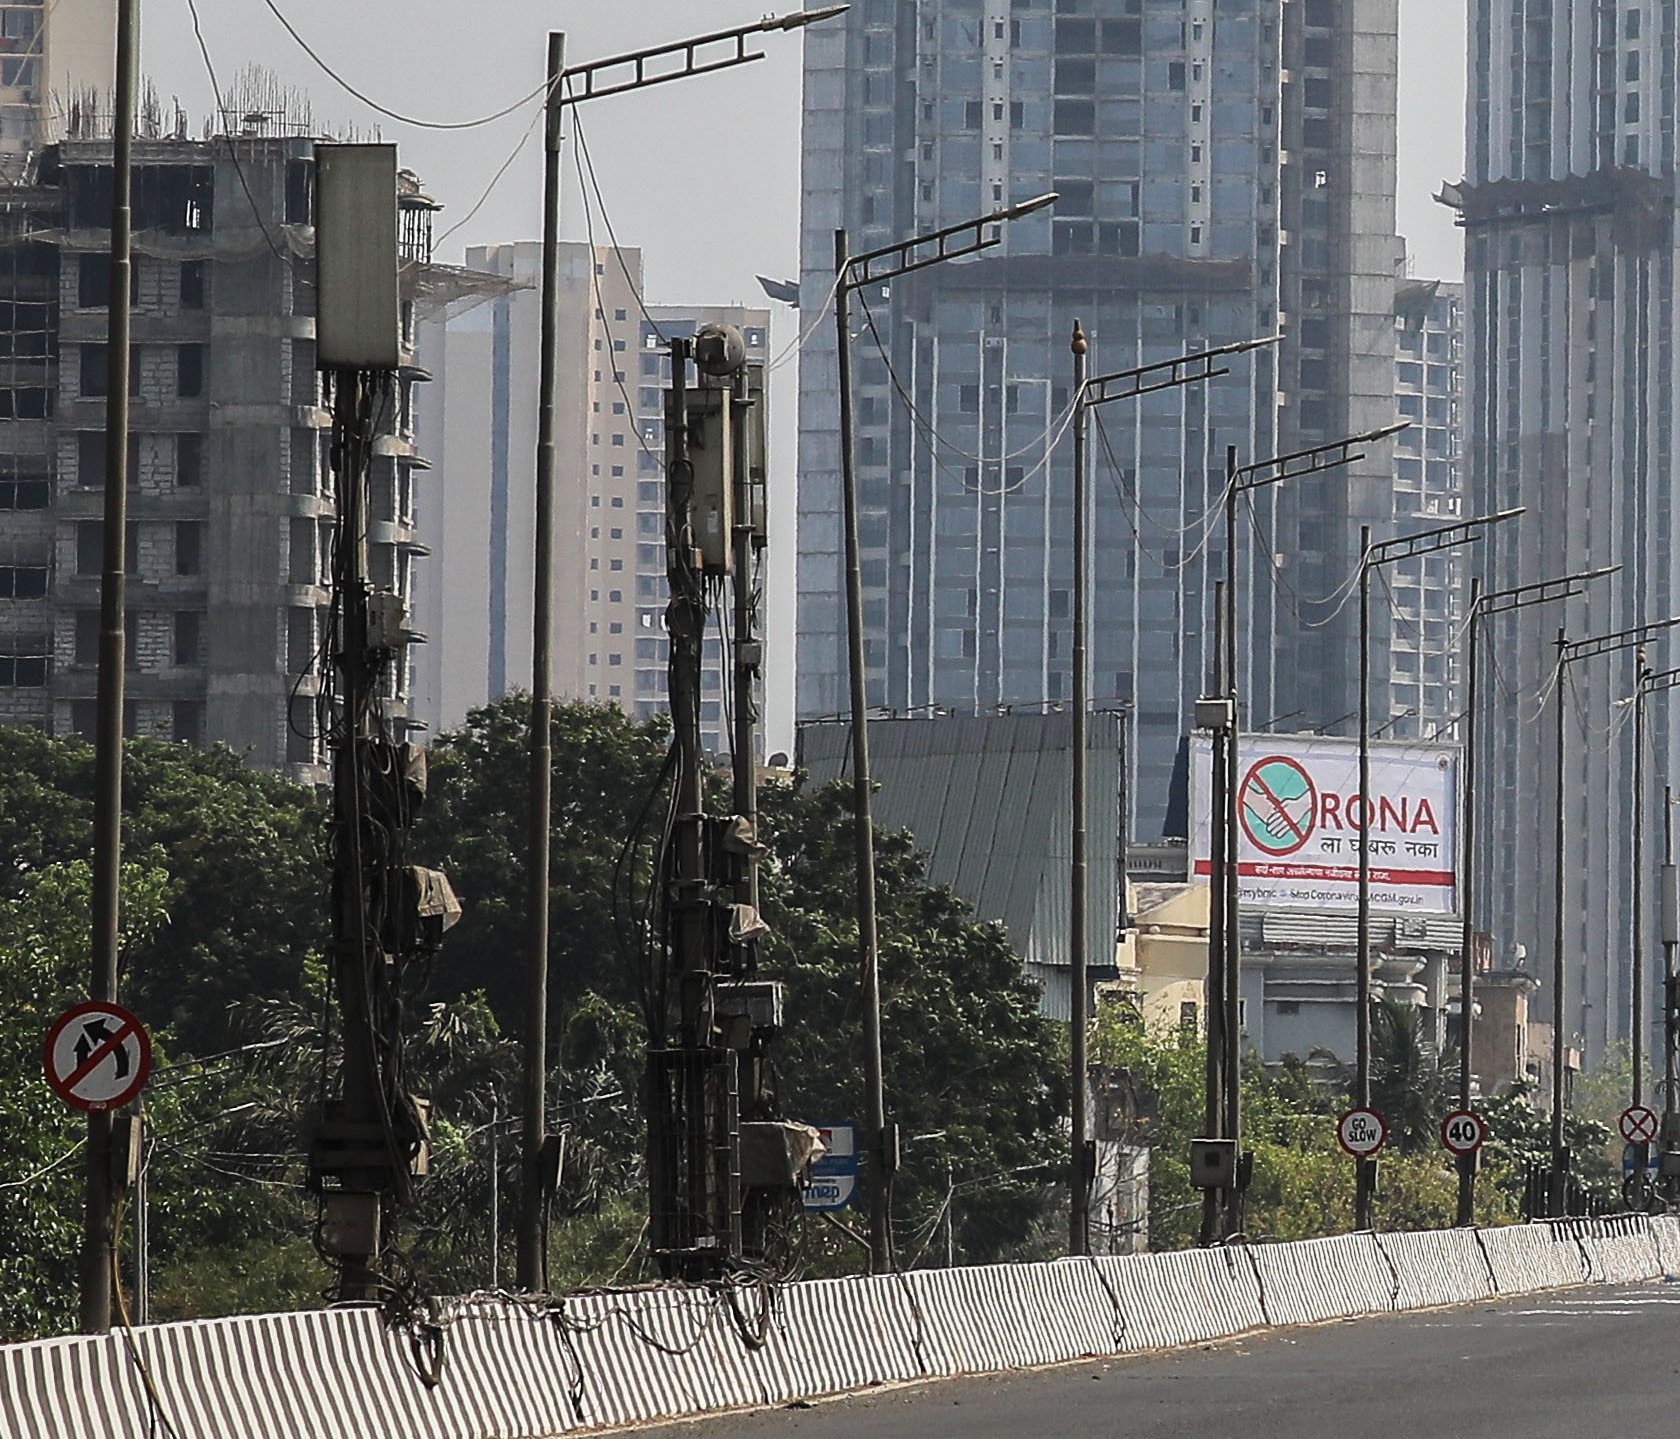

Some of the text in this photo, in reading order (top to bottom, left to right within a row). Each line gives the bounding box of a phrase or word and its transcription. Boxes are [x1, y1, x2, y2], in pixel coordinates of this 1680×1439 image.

[1320, 792, 1439, 835] RONA
[1321, 837, 1439, 858] ला घबरू नका
[1351, 1117, 1366, 1130] GO
[1449, 1121, 1476, 1142] 40
[1348, 1129, 1377, 1143] SLOW
